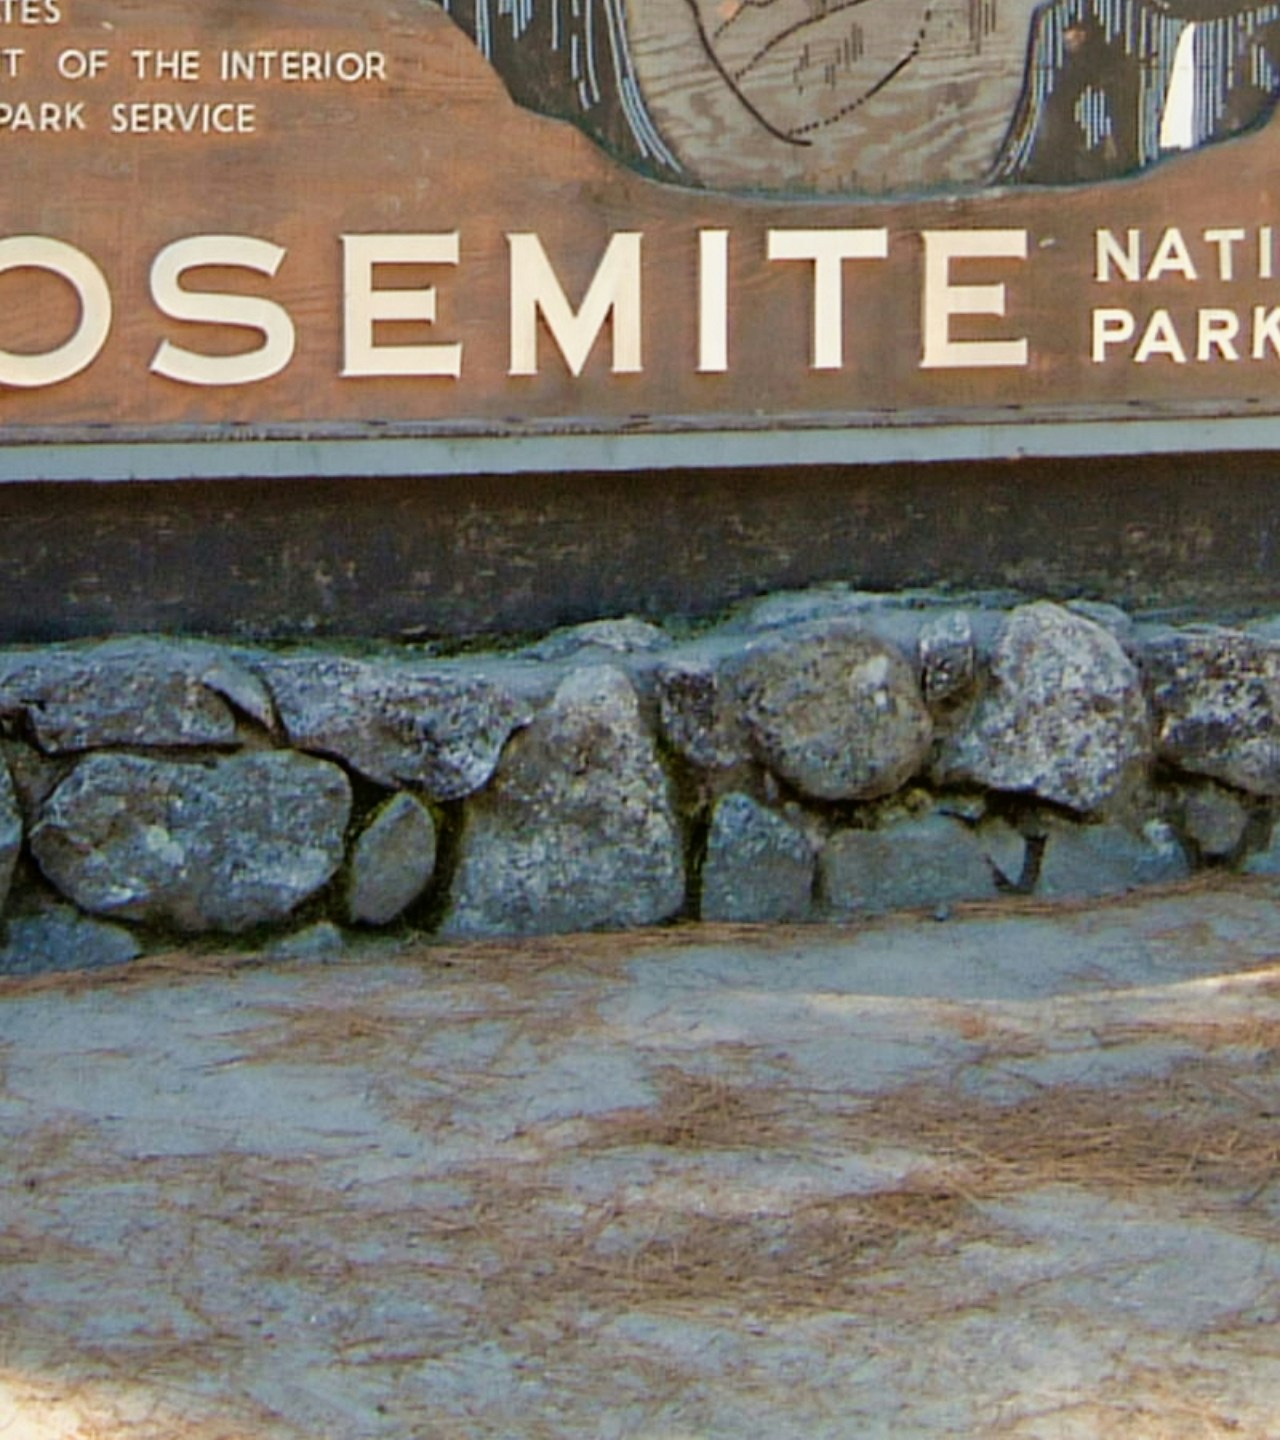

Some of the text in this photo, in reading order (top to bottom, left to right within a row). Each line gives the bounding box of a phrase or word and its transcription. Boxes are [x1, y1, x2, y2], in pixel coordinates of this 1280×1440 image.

[57, 48, 109, 79] OF
[130, 49, 201, 80] THE
[220, 49, 387, 82] INTERIOR
[110, 102, 257, 134] SERVICE
